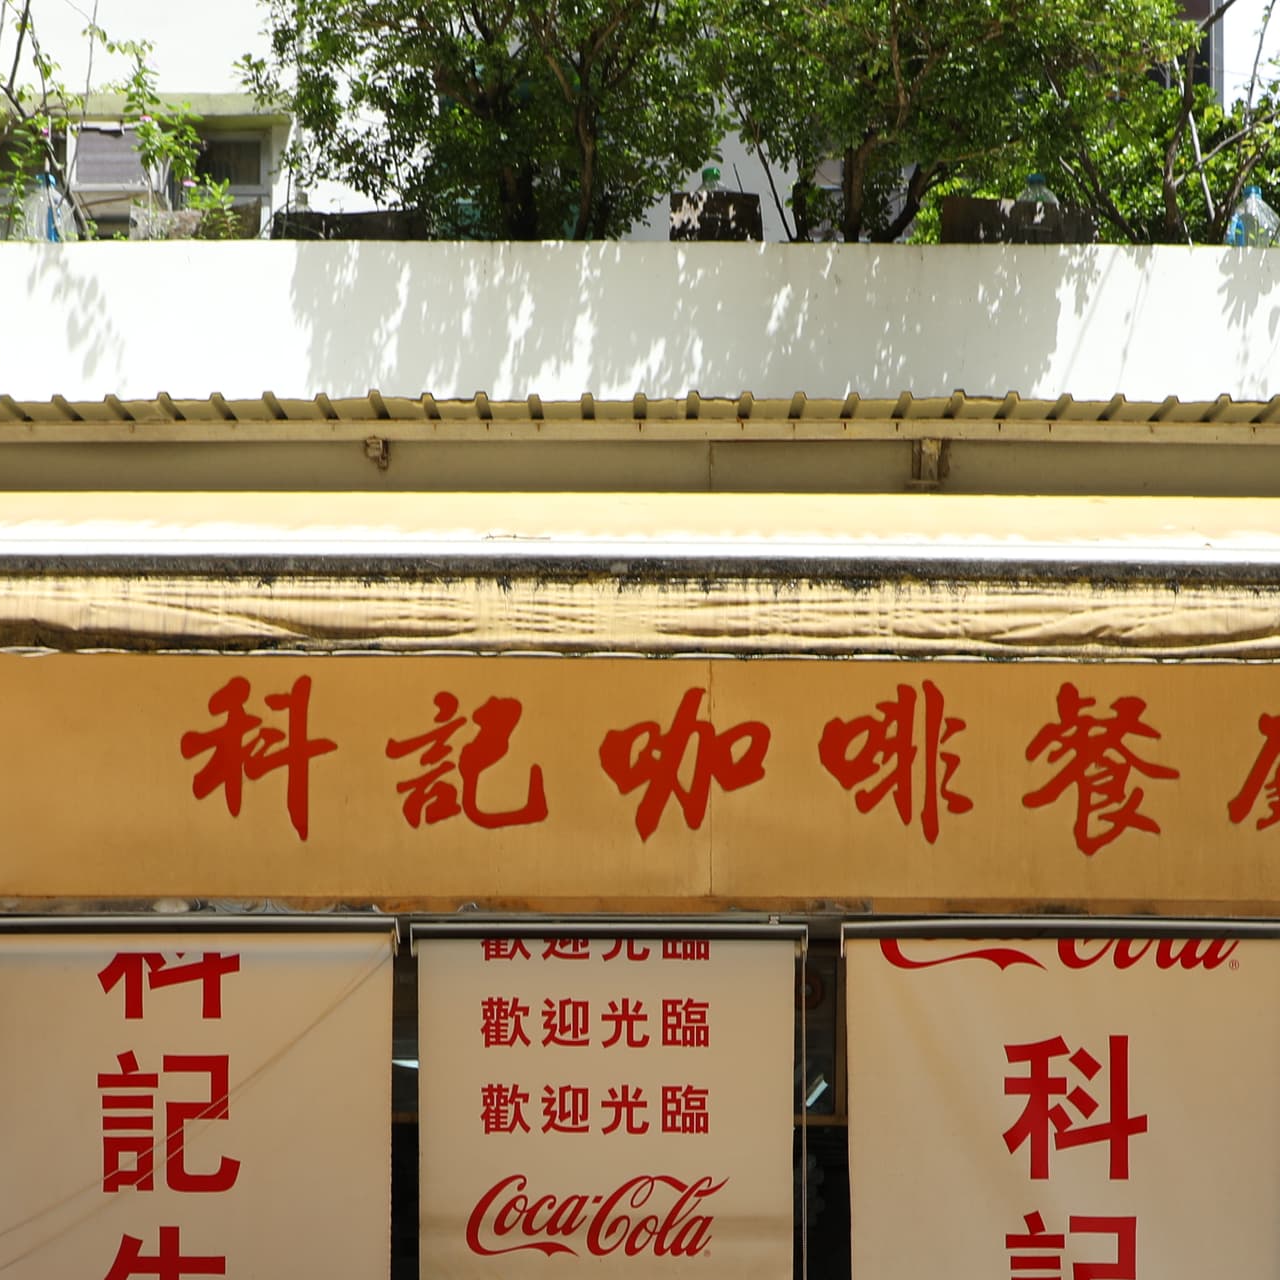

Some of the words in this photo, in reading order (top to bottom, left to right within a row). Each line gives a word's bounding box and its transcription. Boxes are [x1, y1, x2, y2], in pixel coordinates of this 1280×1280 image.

[481, 997, 710, 1048] 歡迎光臨
[481, 1083, 710, 1135] 歡迎光臨
[466, 1174, 730, 1257] Coca-Cola
